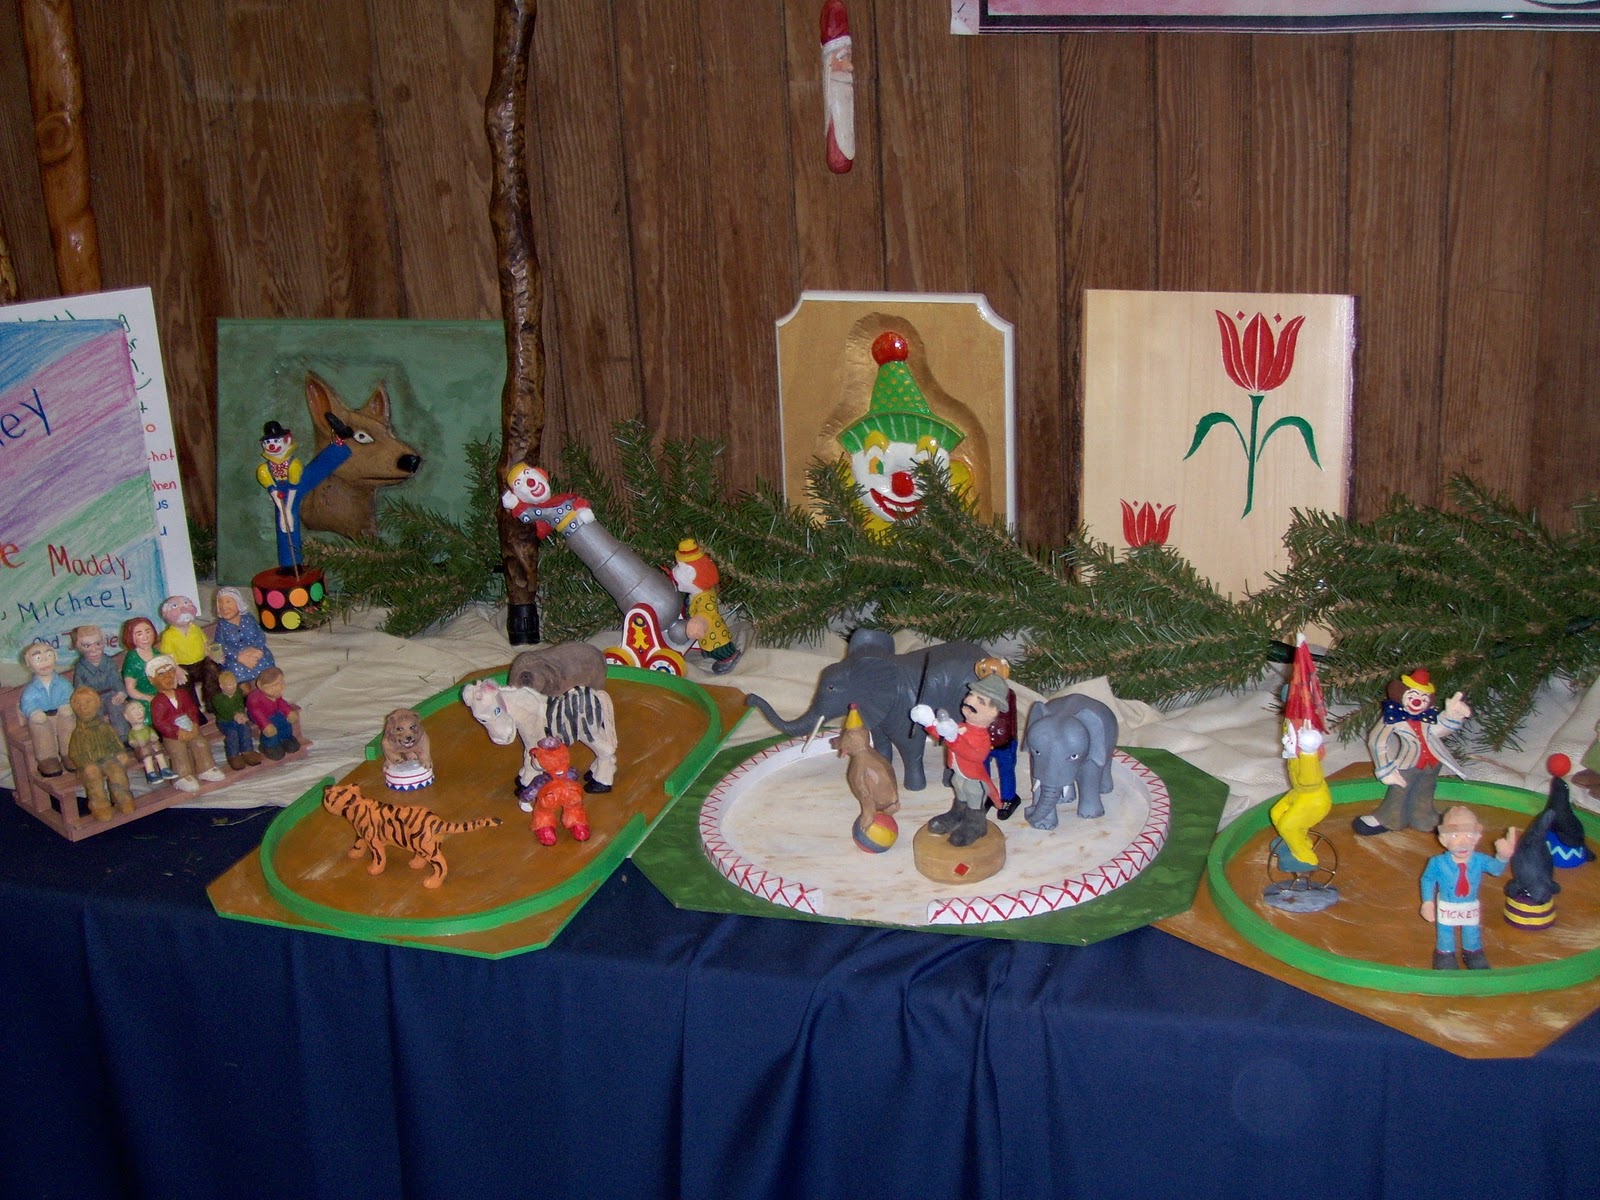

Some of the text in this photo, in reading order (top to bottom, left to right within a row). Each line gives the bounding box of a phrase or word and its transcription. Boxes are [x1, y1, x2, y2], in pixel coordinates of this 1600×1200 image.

[0, 388, 51, 447] ey
[148, 448, 175, 462] hat
[152, 480, 177, 492] hen
[48, 543, 131, 581] Maddy,
[17, 586, 132, 623] Michael,
